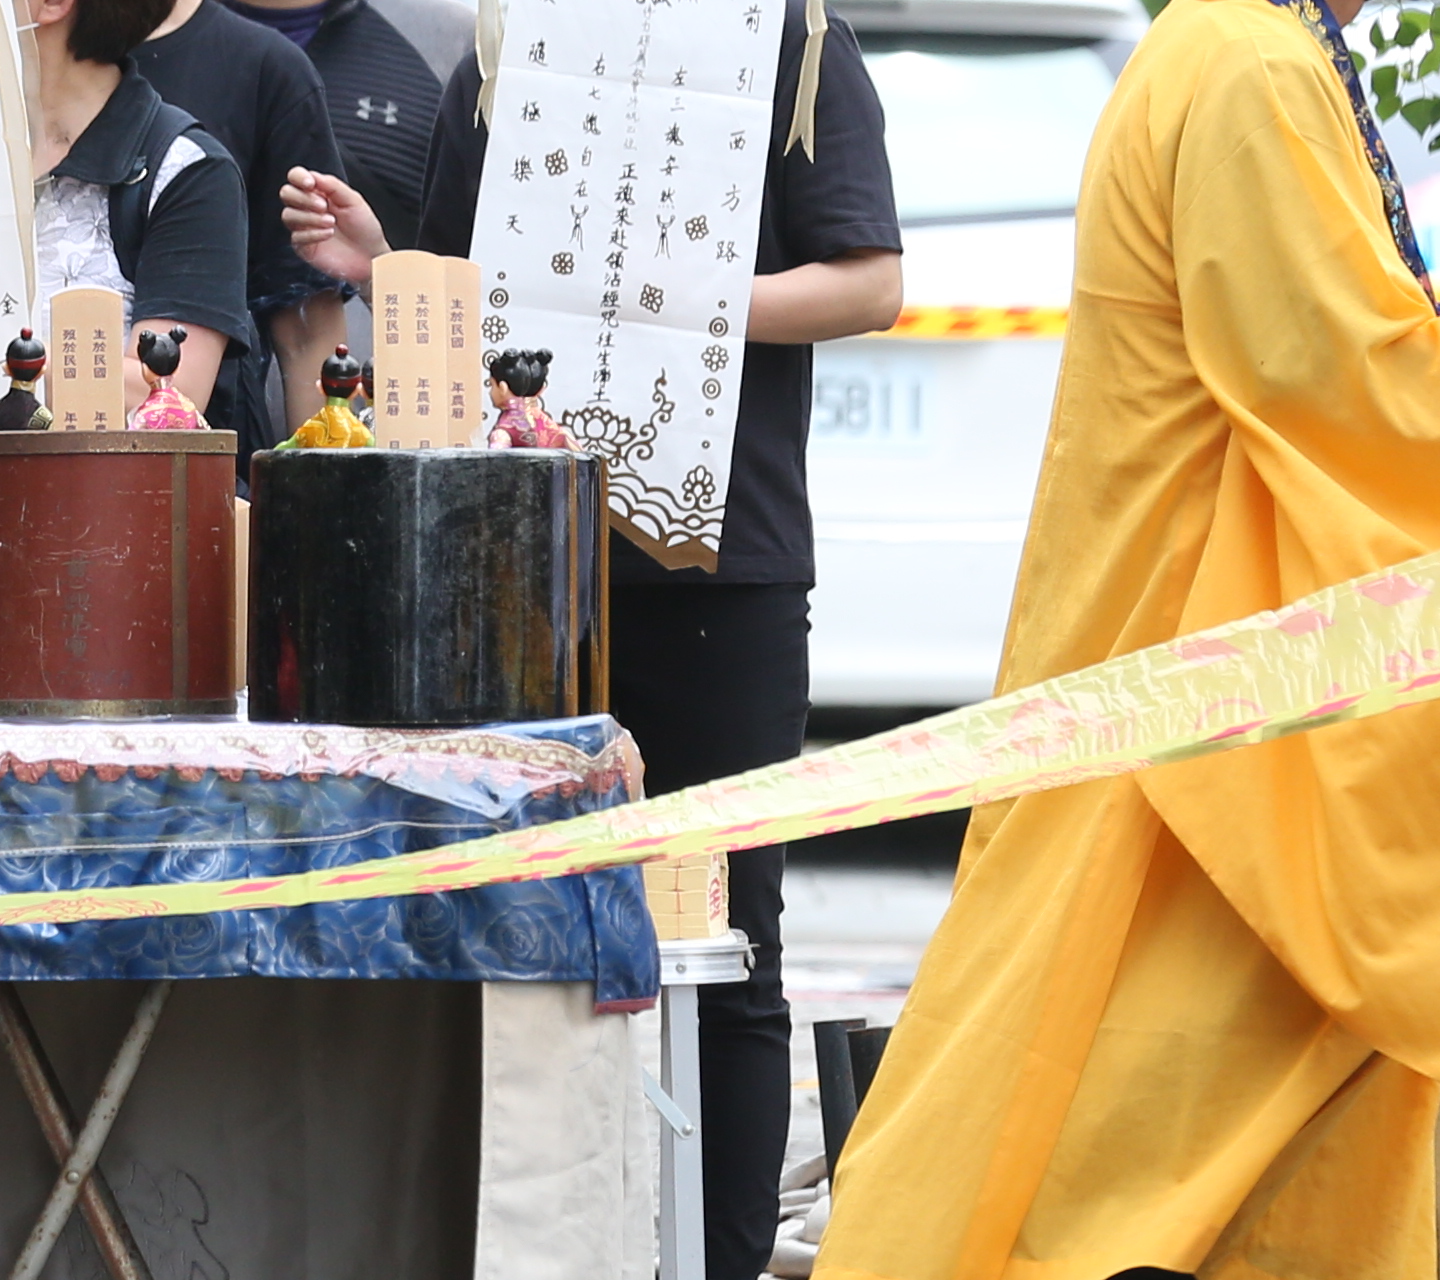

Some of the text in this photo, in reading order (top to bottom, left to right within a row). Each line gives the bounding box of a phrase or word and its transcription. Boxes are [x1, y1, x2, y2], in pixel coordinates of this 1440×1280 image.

[415, 294, 429, 344] 生於民國
[450, 298, 464, 349] 生於民國
[92, 328, 107, 378] 生於民國
